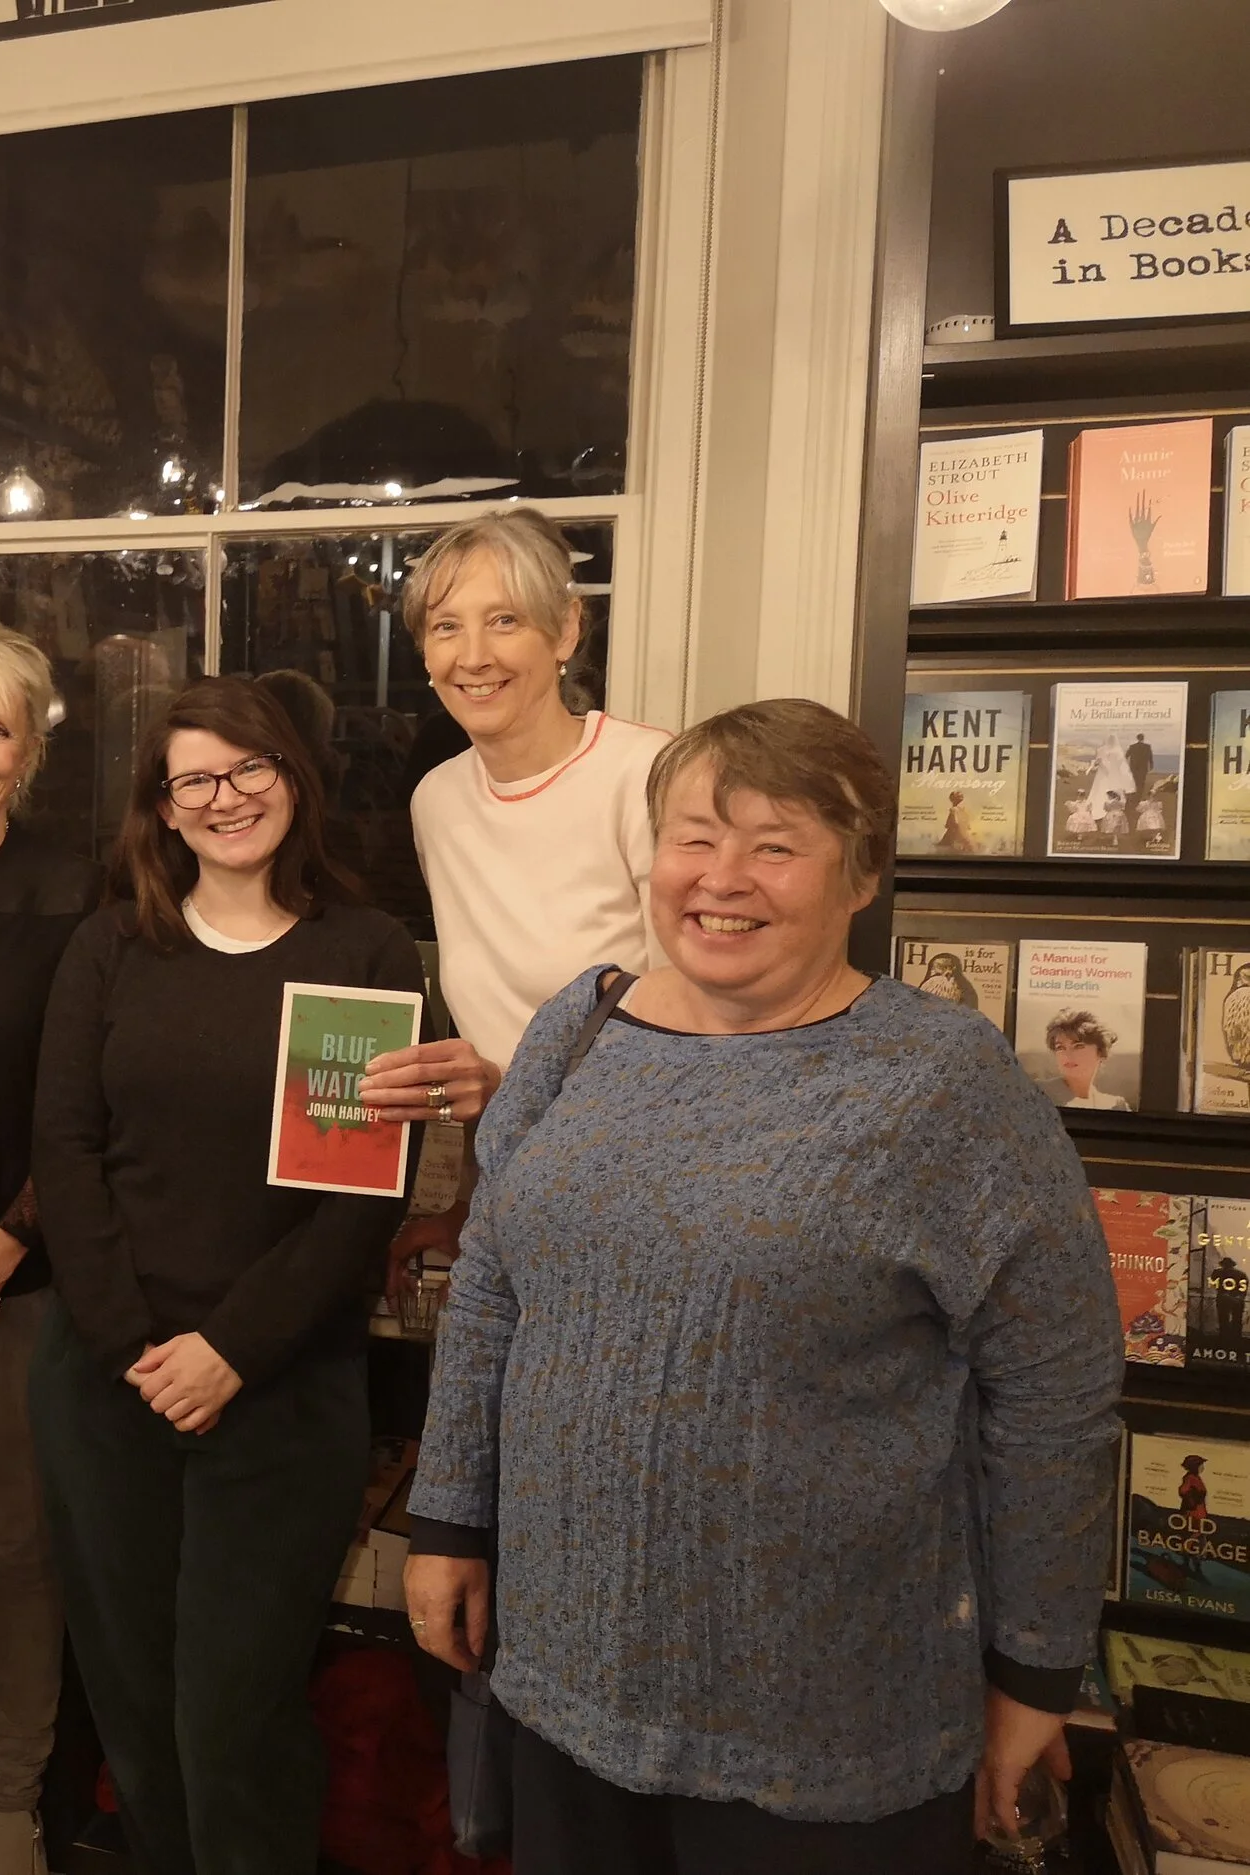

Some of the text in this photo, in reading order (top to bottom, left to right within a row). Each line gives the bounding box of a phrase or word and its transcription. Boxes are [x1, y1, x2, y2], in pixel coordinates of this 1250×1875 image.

[1048, 206, 1250, 245] A Decad
[1052, 248, 1250, 285] in Book
[928, 452, 1029, 473] ELIZABETH
[1119, 447, 1175, 465] Auntie
[928, 469, 1001, 486] STROUT
[927, 490, 980, 507] Olive
[926, 505, 1029, 527] Kitteridge
[1085, 698, 1159, 707] Elena Ferrante
[921, 709, 1003, 739] KENT
[1070, 708, 1172, 721] My Brilliant Friend
[906, 744, 1014, 774] HARUF
[906, 944, 995, 966] H is for
[1030, 952, 1108, 965] A Manual for
[1209, 953, 1233, 976] H
[962, 958, 1005, 975] Hawk
[1029, 965, 1133, 979] Cleaning Women
[1029, 979, 1100, 991] Lucia Berlin
[306, 1102, 381, 1123] JOHN HARVEY
[1192, 1347, 1237, 1362] AMOR
[1167, 1513, 1217, 1535] OLD
[1137, 1529, 1248, 1563] BAGGAGE
[1145, 1588, 1237, 1614] LISSA EVANS
